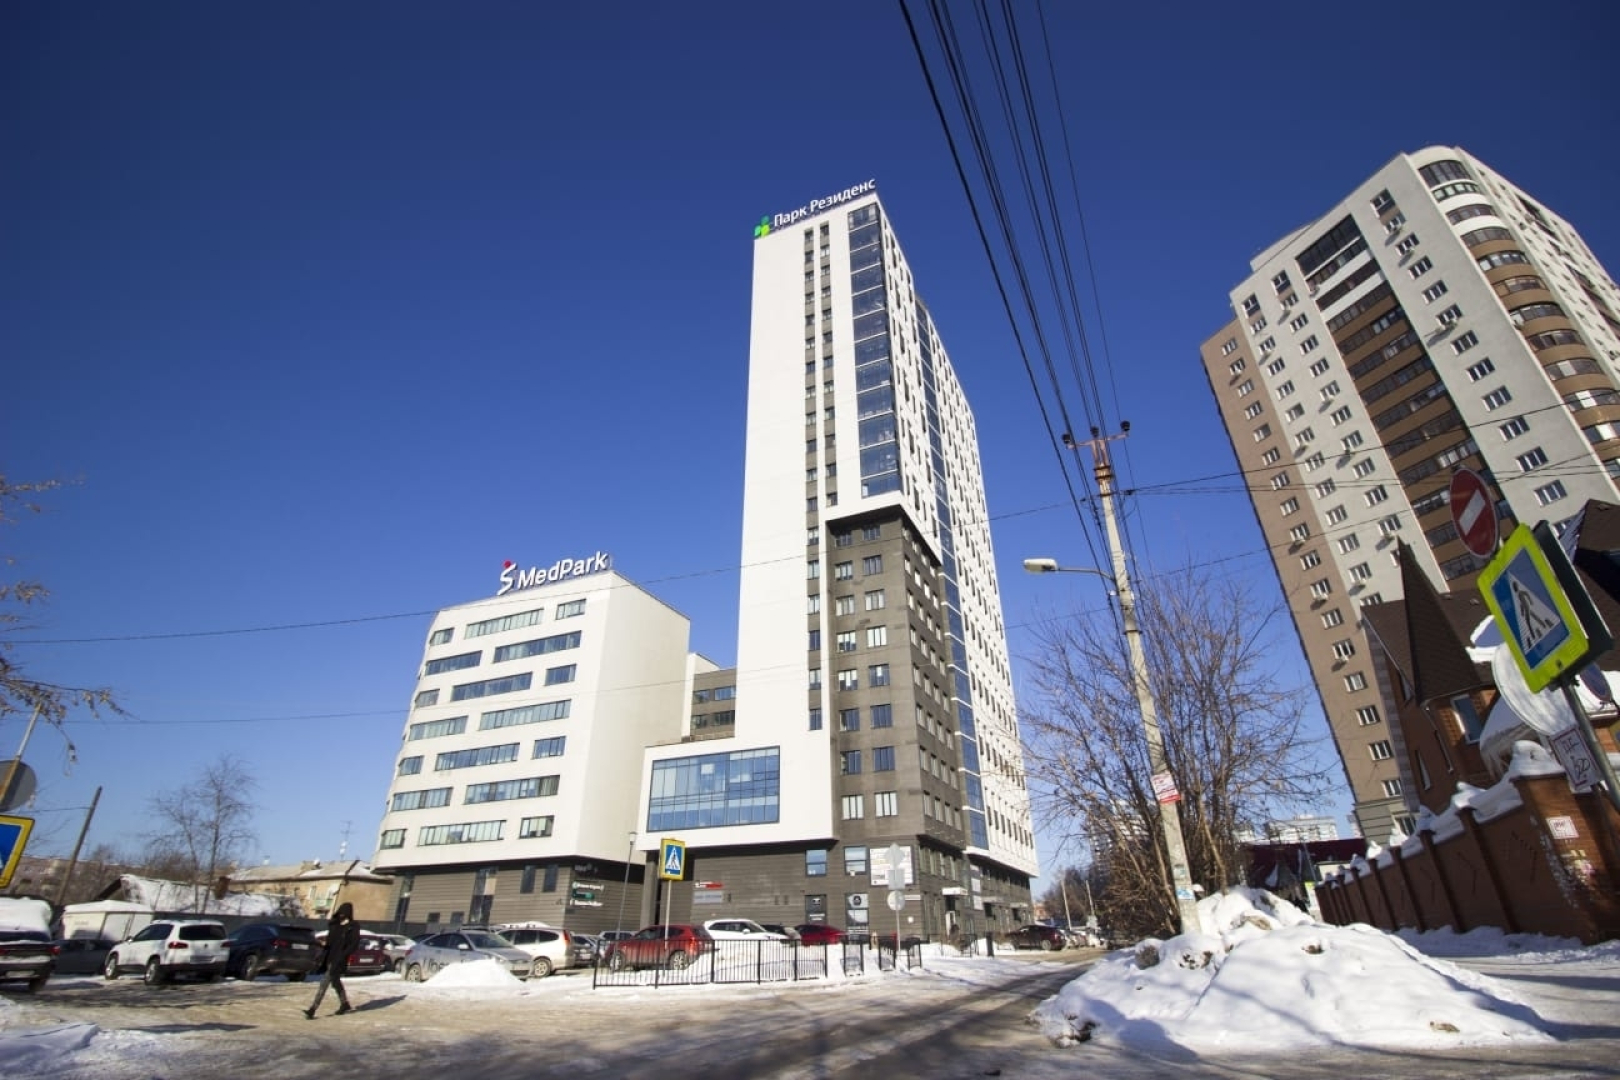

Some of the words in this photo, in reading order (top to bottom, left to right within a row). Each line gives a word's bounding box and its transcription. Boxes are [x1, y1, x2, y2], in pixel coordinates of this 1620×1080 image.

[773, 205, 808, 227] Парк
[809, 178, 876, 213] Резиденс
[517, 550, 608, 589] MedPark
